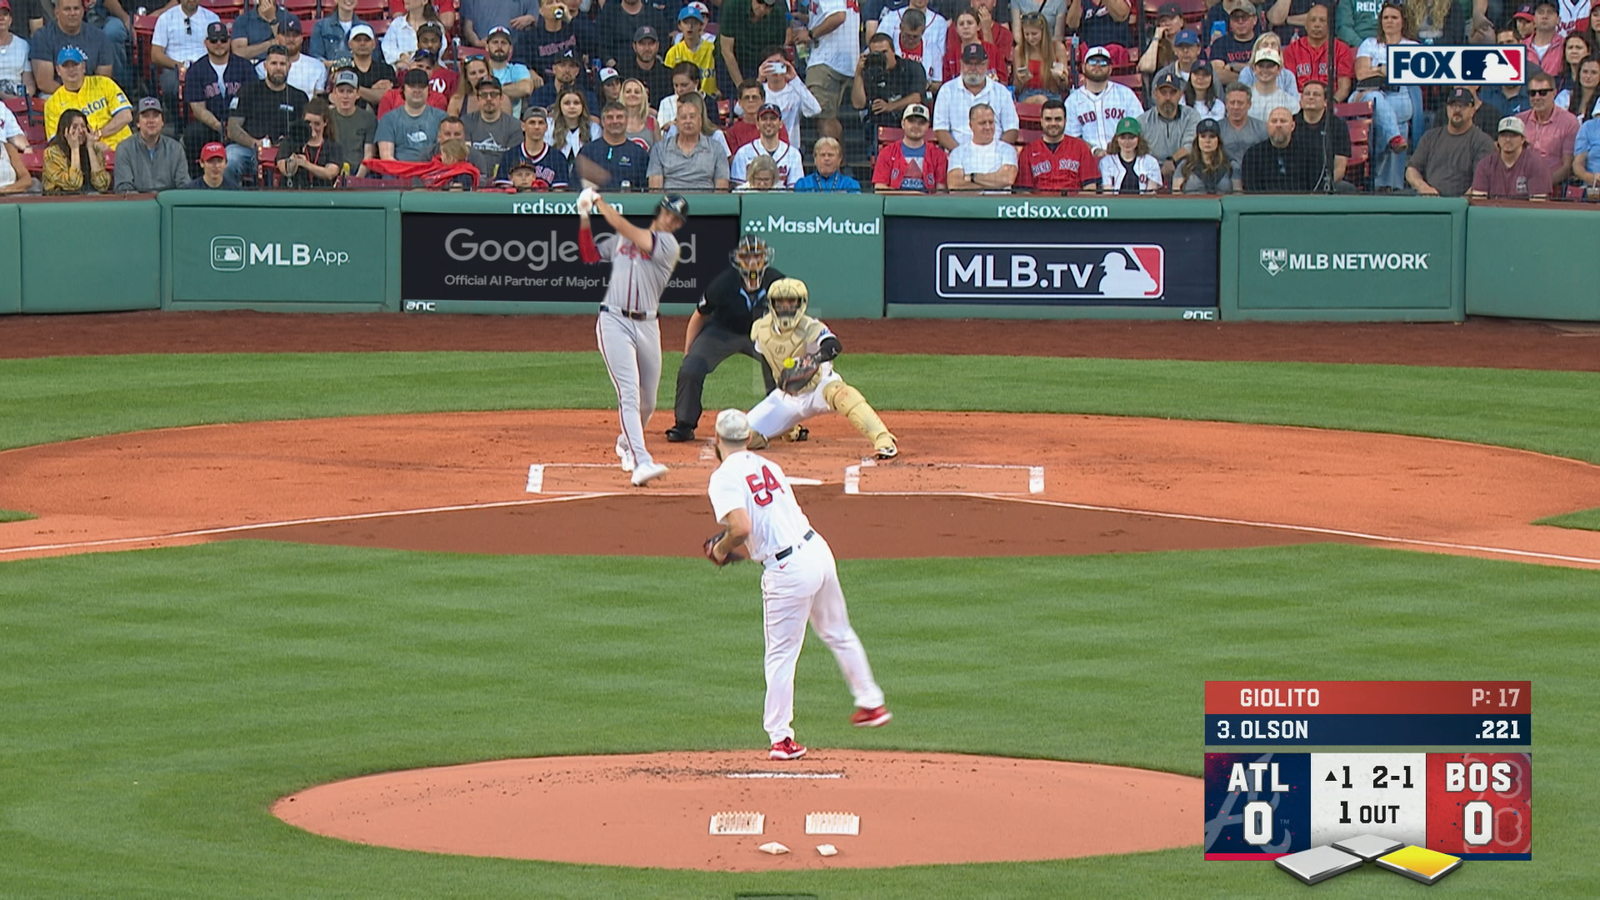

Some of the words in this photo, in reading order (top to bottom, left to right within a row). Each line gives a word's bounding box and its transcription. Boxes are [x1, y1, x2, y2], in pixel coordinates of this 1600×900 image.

[1077, 110, 1097, 126] RED
[1104, 107, 1125, 119] SOX
[1031, 160, 1052, 178] RED
[1059, 158, 1080, 173] SOX
[997, 201, 1109, 218] redsox.com
[768, 215, 880, 236] MassMutual
[249, 243, 311, 266] MLB
[313, 248, 350, 267] App
[444, 228, 579, 271] Google
[947, 254, 1095, 289] MLB.TV
[1289, 253, 1329, 270] MLB
[1332, 253, 1429, 270] NETWORK
[444, 274, 487, 286] Official
[489, 275, 502, 286] AI
[504, 275, 549, 287] Partner
[550, 276, 564, 287] of
[566, 276, 600, 290] Major
[745, 464, 785, 508] 54
